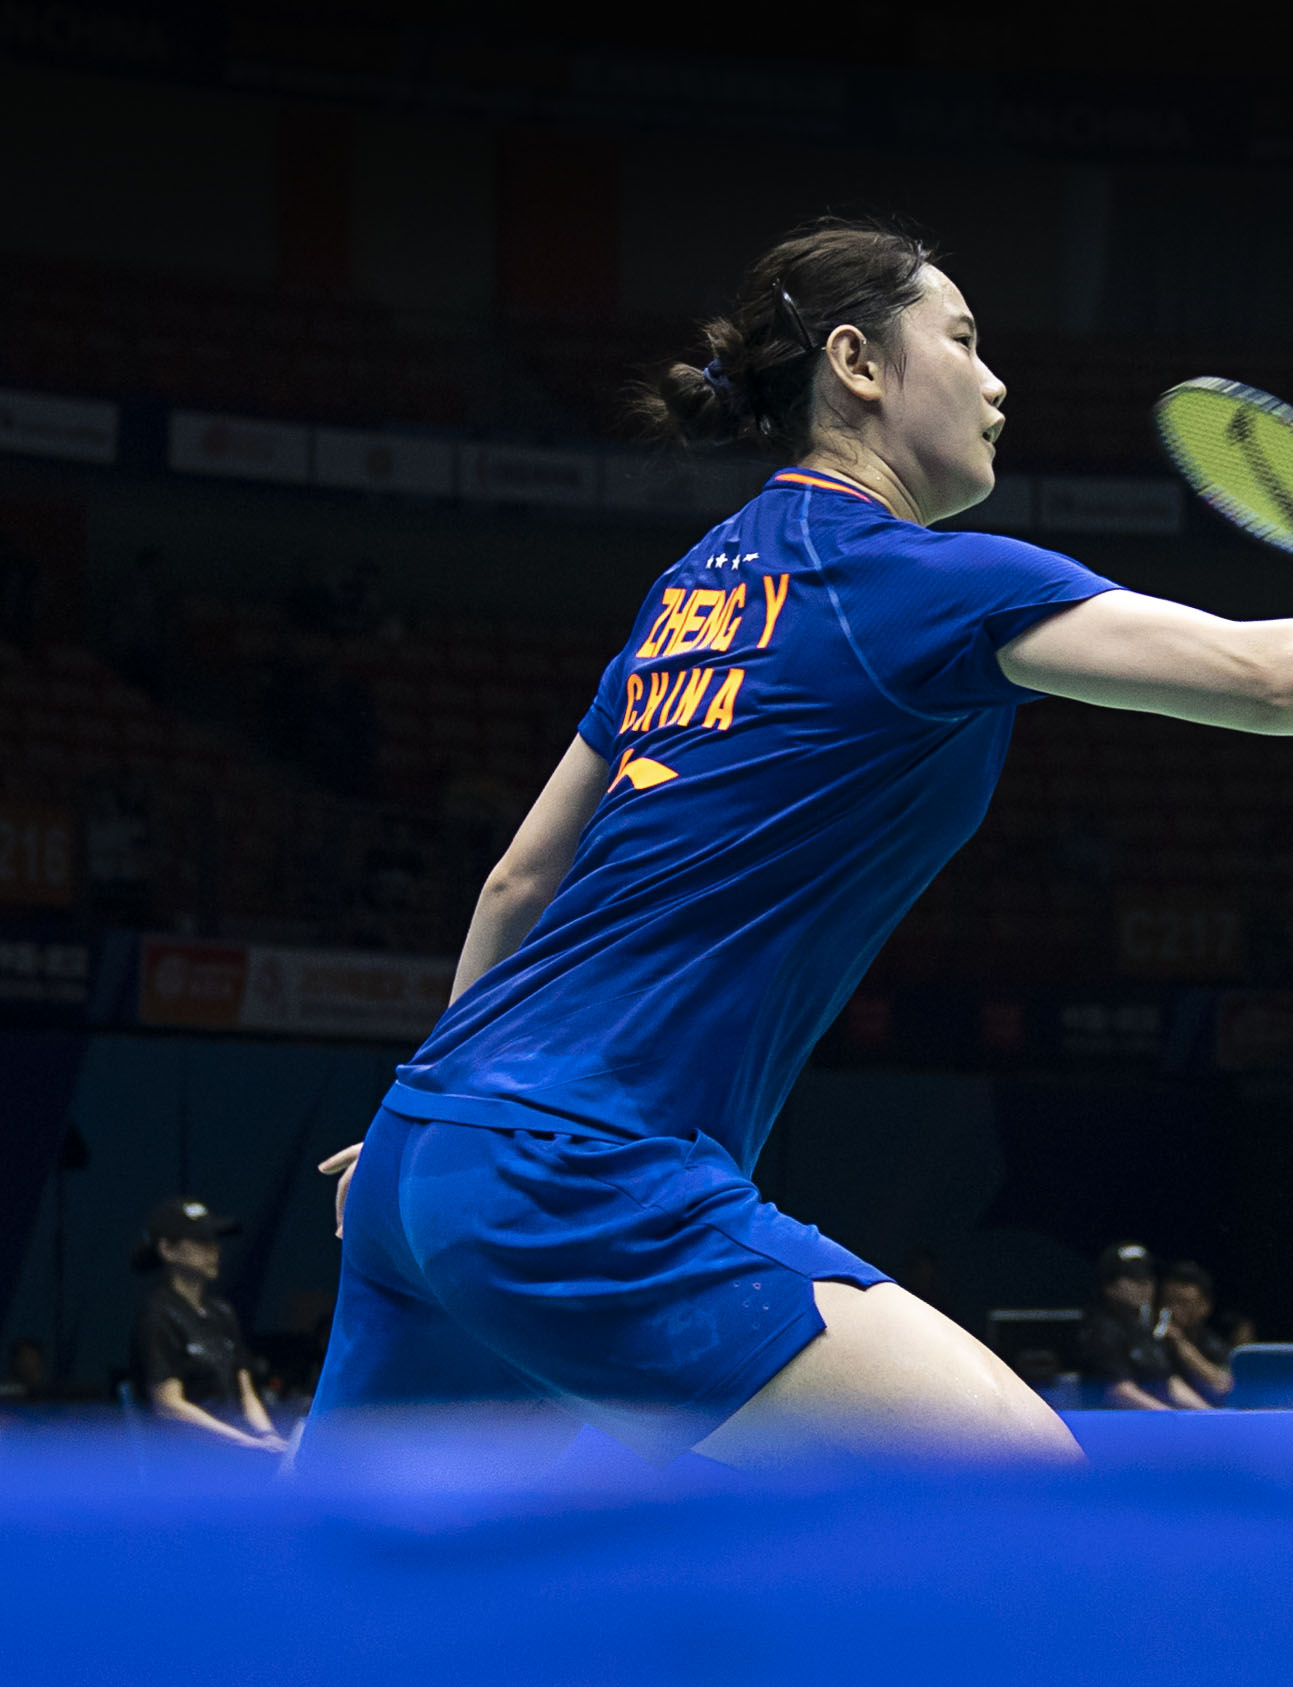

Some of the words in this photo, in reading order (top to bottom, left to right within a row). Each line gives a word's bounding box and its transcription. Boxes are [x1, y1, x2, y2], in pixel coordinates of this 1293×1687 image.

[635, 582, 746, 659] ZHENG
[756, 573, 790, 649] Y
[619, 667, 746, 735] CHINA
